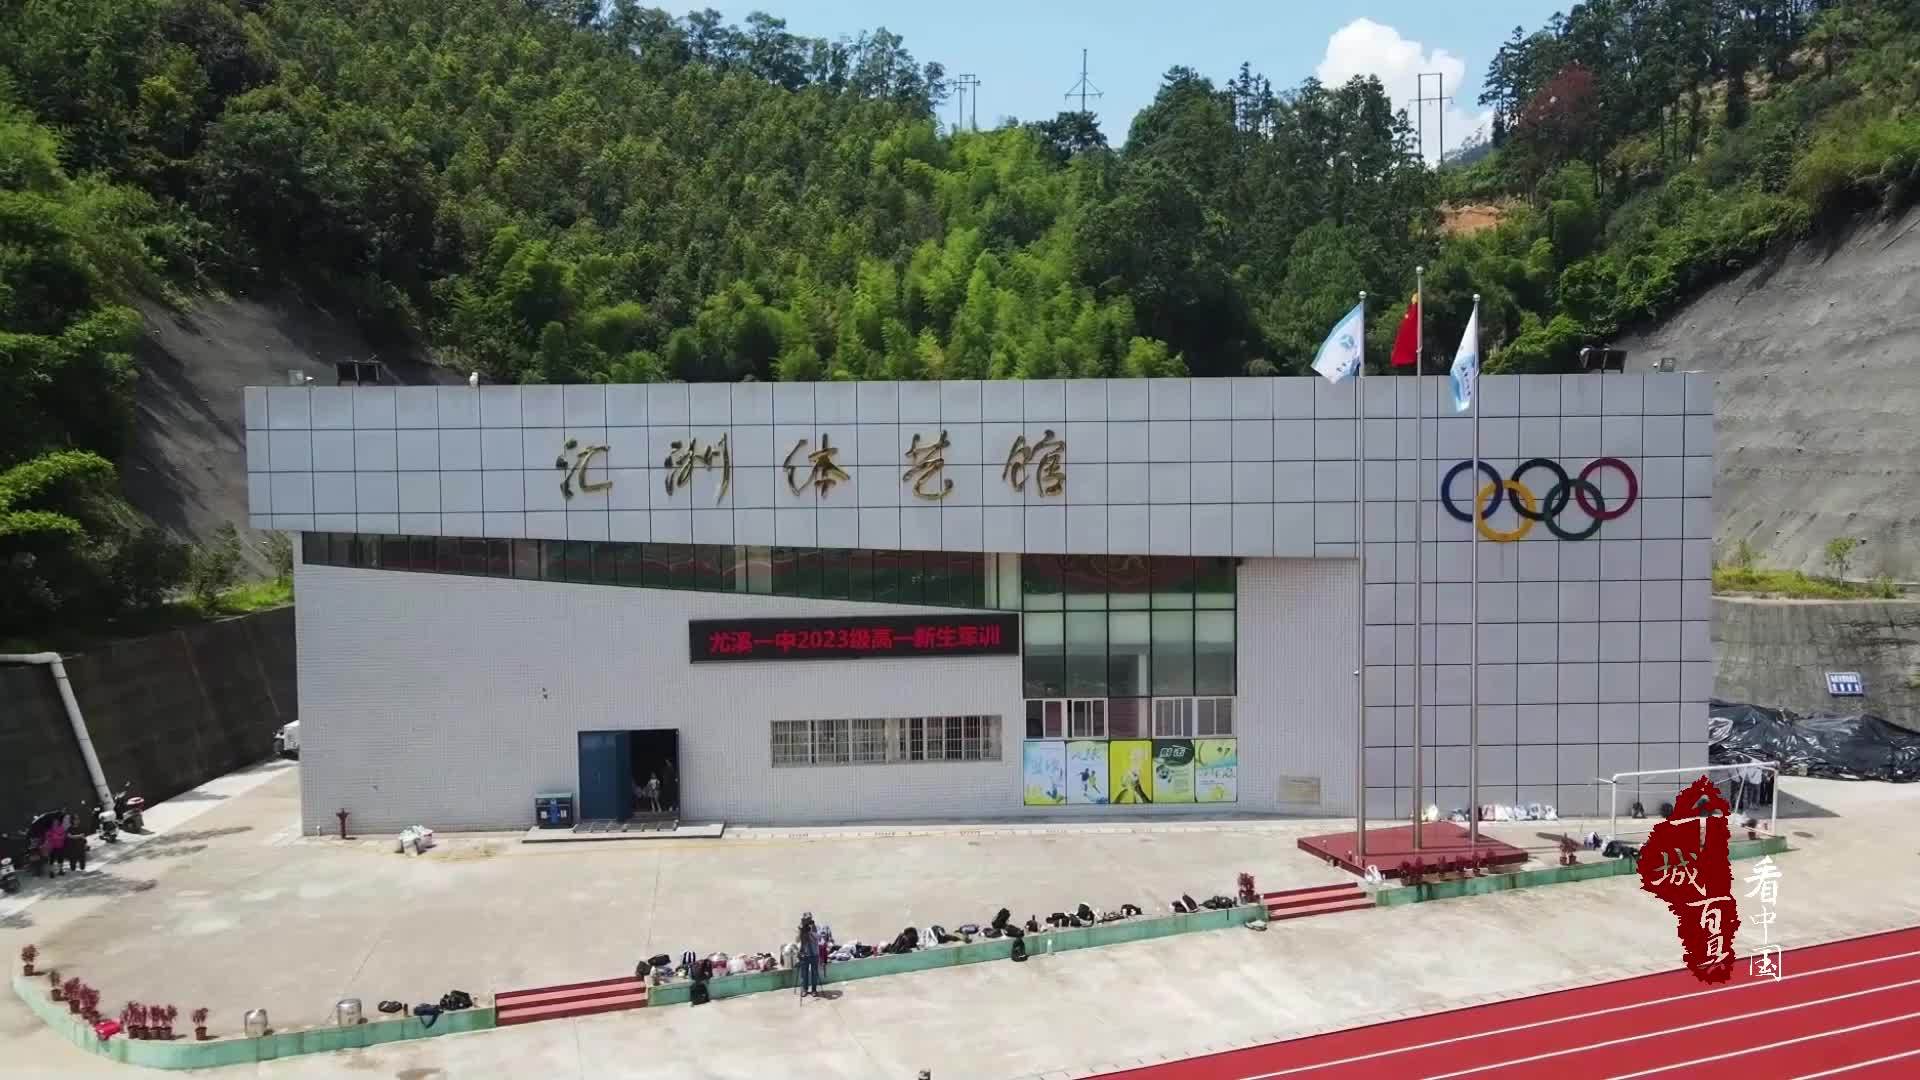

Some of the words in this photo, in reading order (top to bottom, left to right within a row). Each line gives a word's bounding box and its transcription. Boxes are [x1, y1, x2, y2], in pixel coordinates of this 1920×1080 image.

[709, 624, 1001, 655] 尤溪一中2023级高一新生军训
